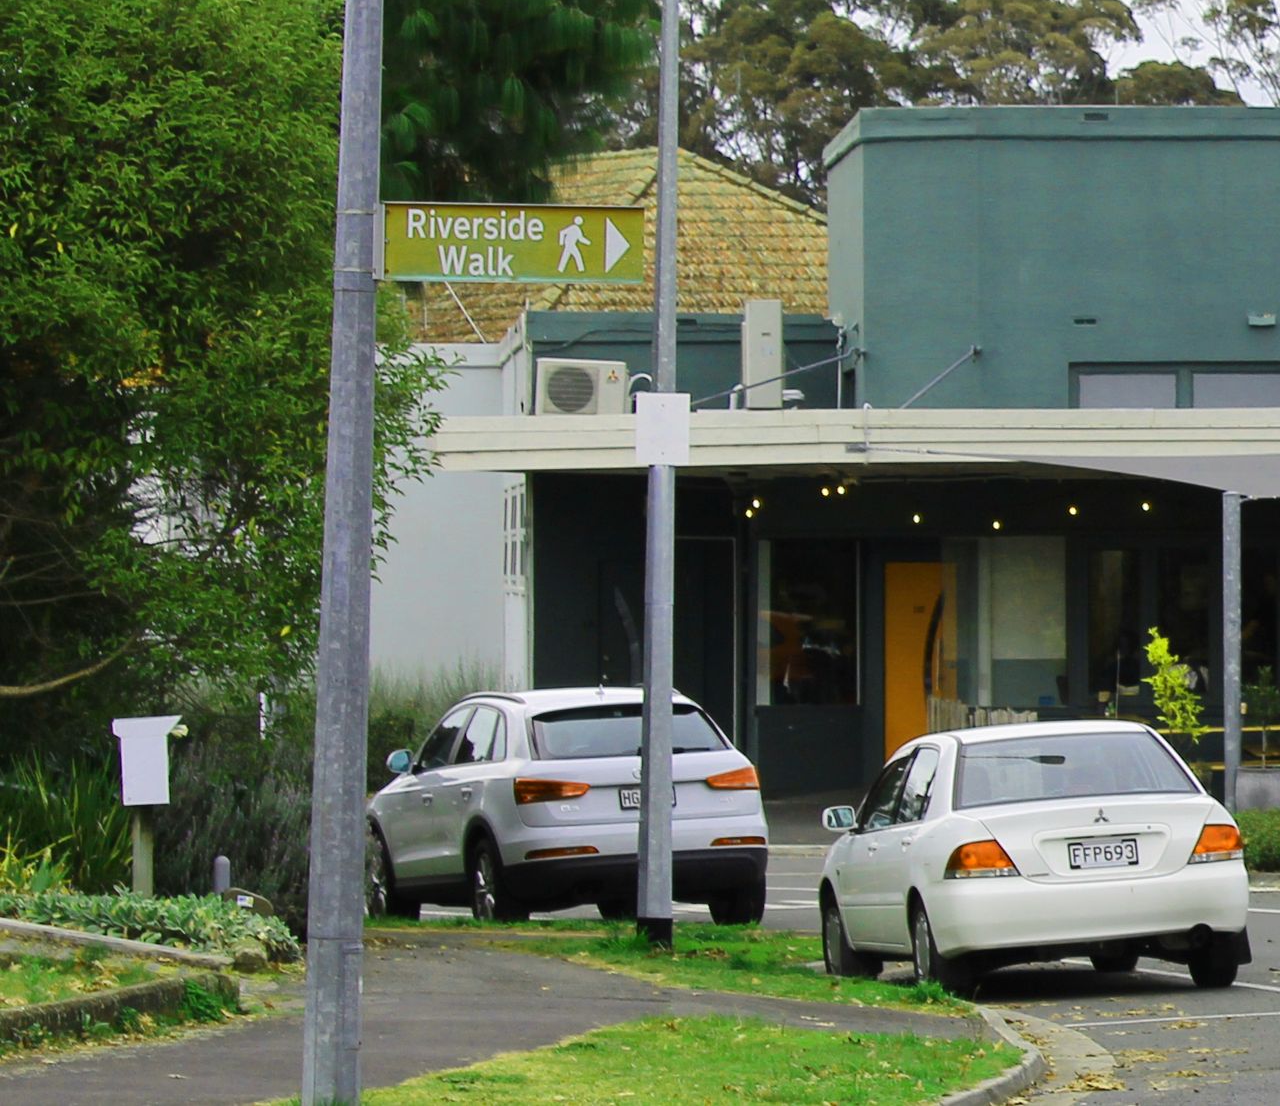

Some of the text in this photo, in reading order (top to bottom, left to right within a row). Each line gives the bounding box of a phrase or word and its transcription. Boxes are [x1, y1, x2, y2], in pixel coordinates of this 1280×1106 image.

[406, 208, 545, 242] Riverside
[437, 245, 515, 278] Walk
[1071, 843, 1136, 864] FFP693
